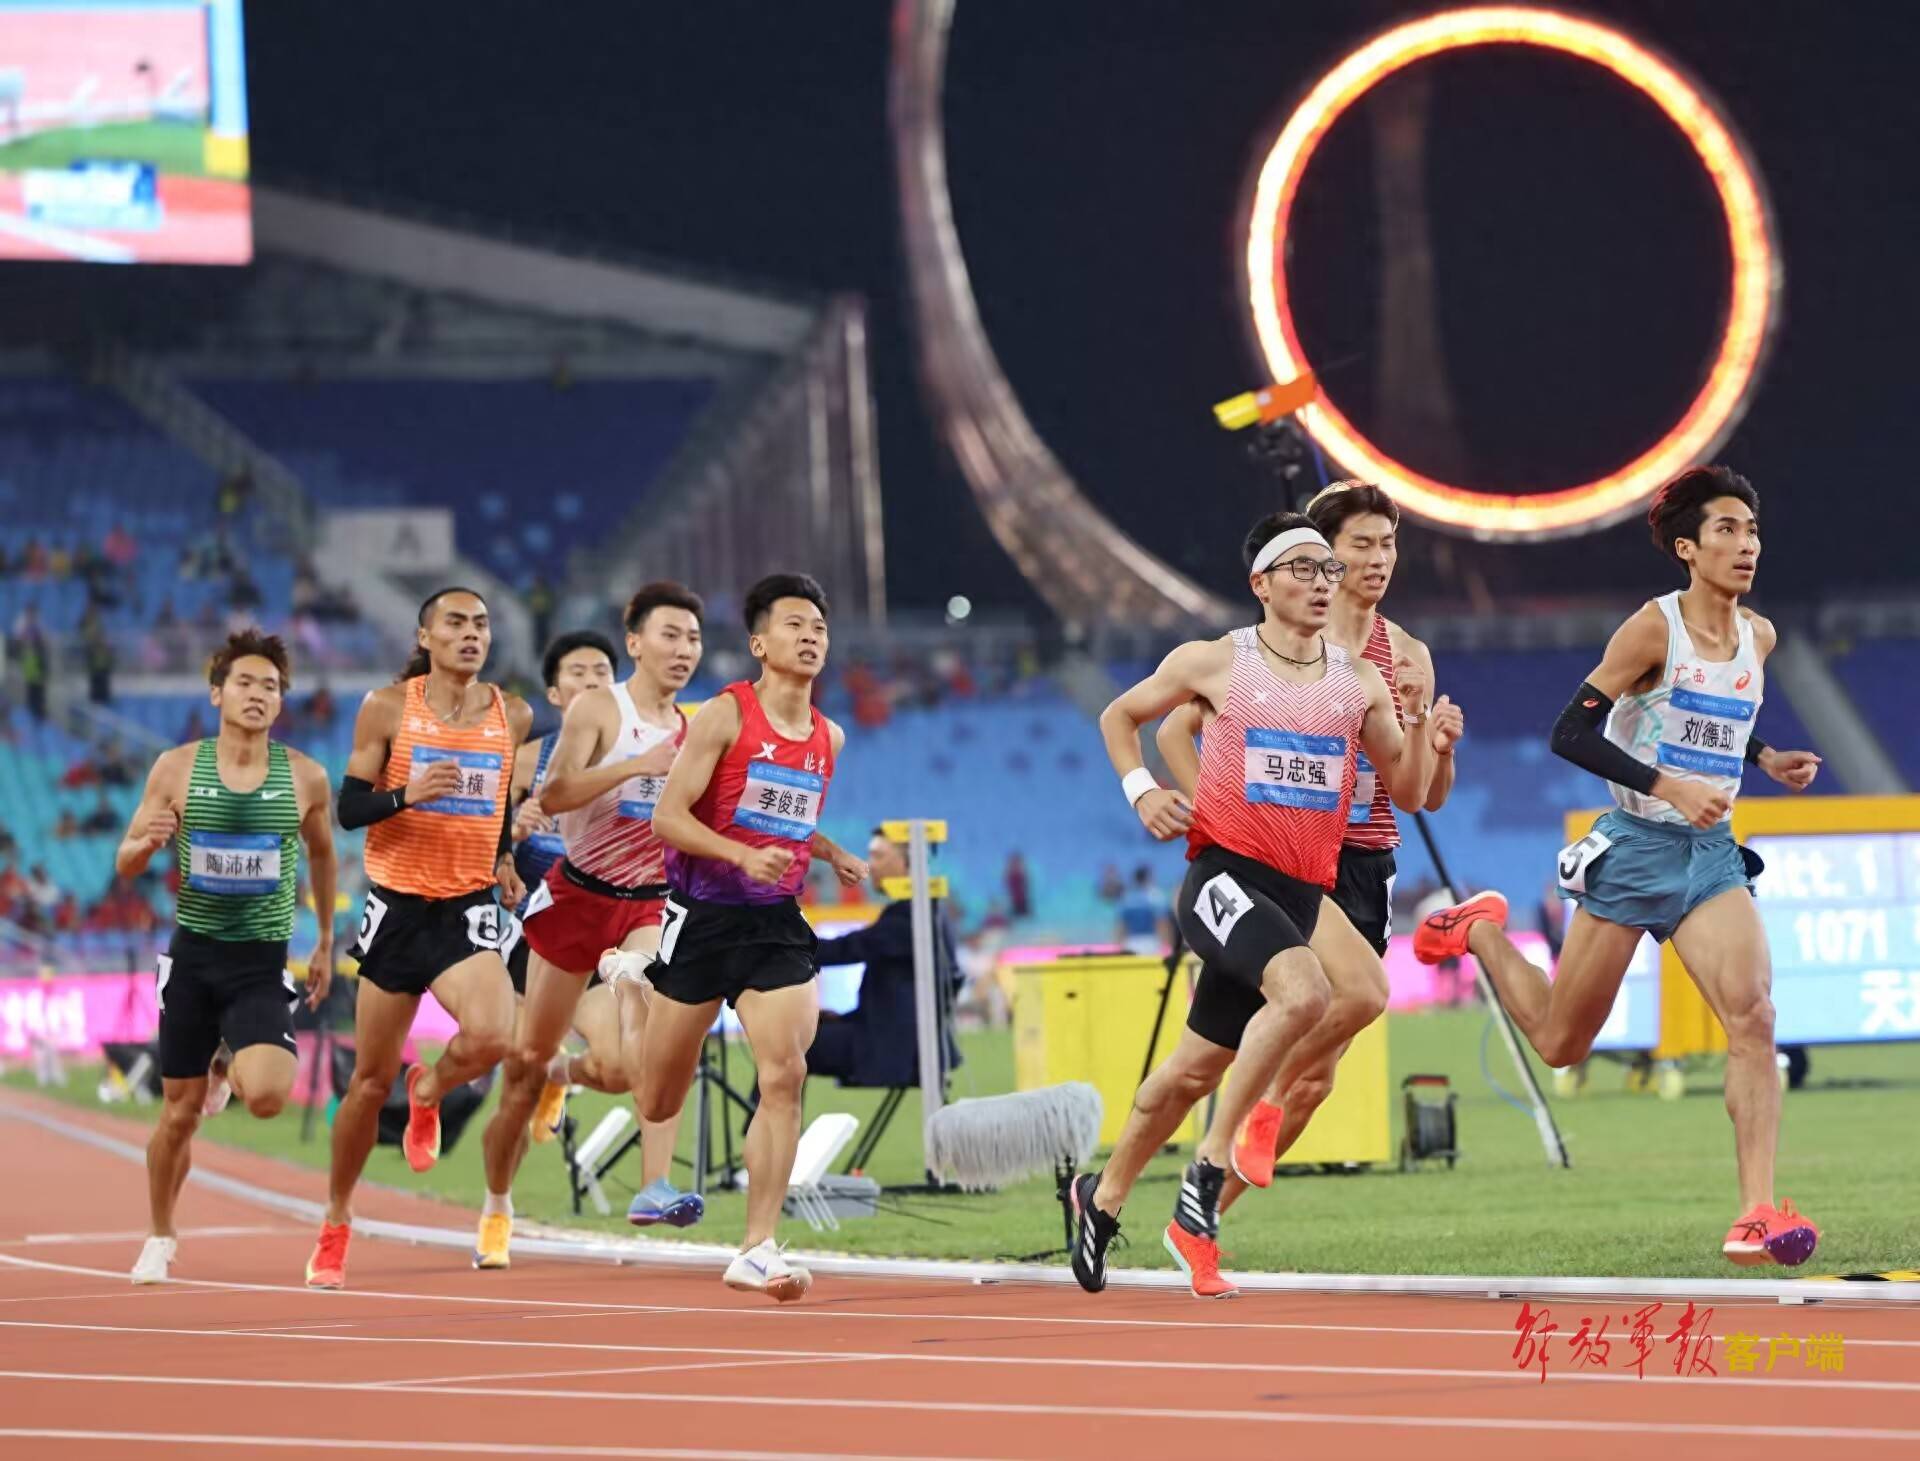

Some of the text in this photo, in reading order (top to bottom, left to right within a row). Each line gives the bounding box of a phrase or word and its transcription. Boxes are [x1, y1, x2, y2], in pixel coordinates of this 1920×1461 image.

[1672, 664, 1705, 685] 广西
[1265, 755, 1327, 786] 马忠强
[758, 787, 809, 818] 李俊霖
[206, 853, 263, 877] 陶沛林
[1560, 836, 1598, 880] 5
[1857, 843, 1878, 894] 1
[1208, 883, 1238, 928] 4
[477, 911, 500, 942] 6
[1795, 908, 1888, 963] 1071
